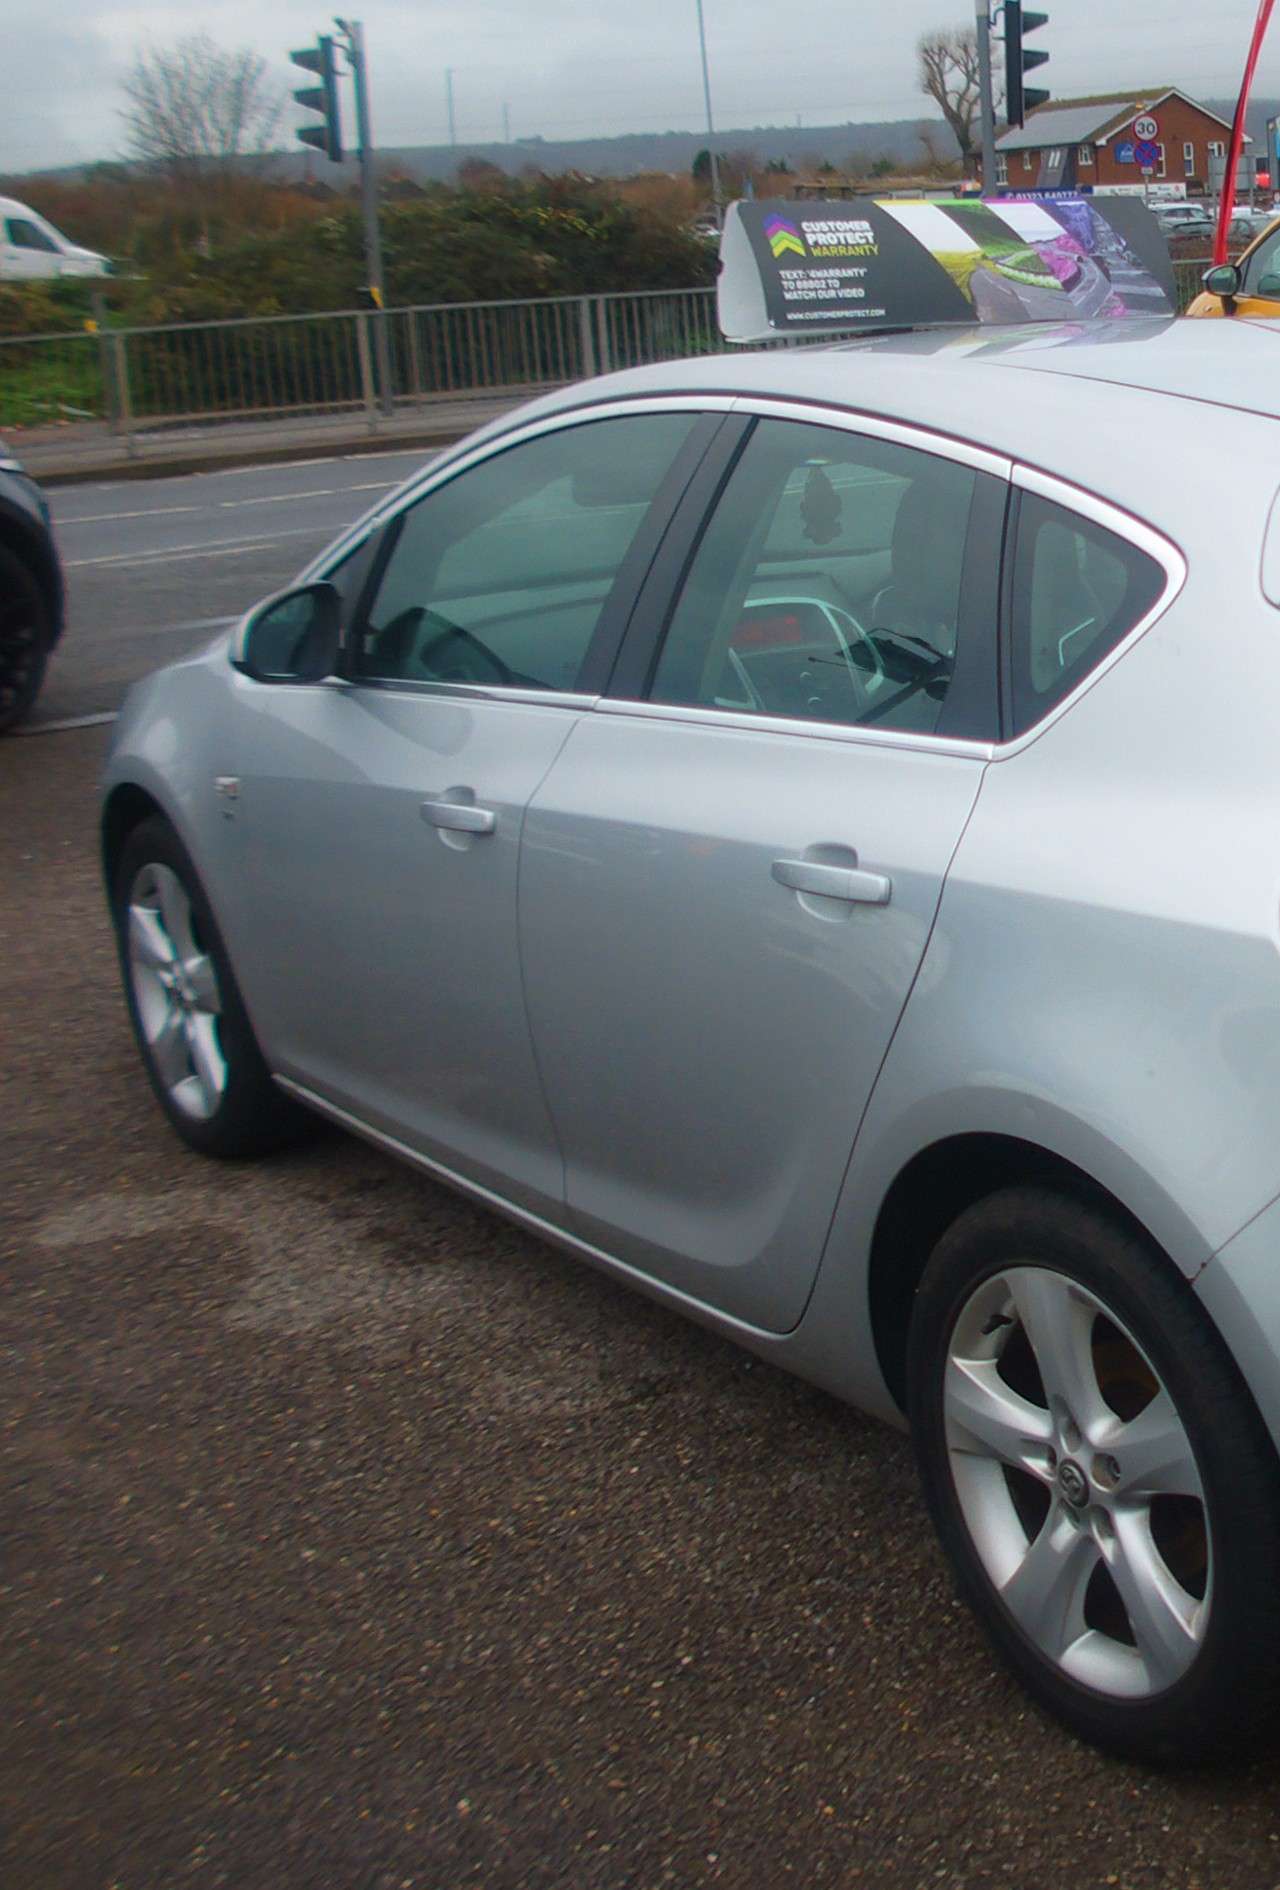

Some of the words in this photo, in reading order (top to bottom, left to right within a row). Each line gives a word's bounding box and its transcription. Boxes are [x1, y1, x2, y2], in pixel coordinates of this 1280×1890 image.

[1137, 122, 1156, 135] 30
[801, 220, 871, 232] CUSTOMER
[805, 232, 875, 246] PROTECT
[811, 244, 879, 257] WARRANTY
[782, 280, 795, 289] TO
[827, 278, 840, 288] TO
[784, 289, 817, 300] WATCH
[817, 288, 837, 299] OUR
[837, 287, 865, 298] VIDEO
